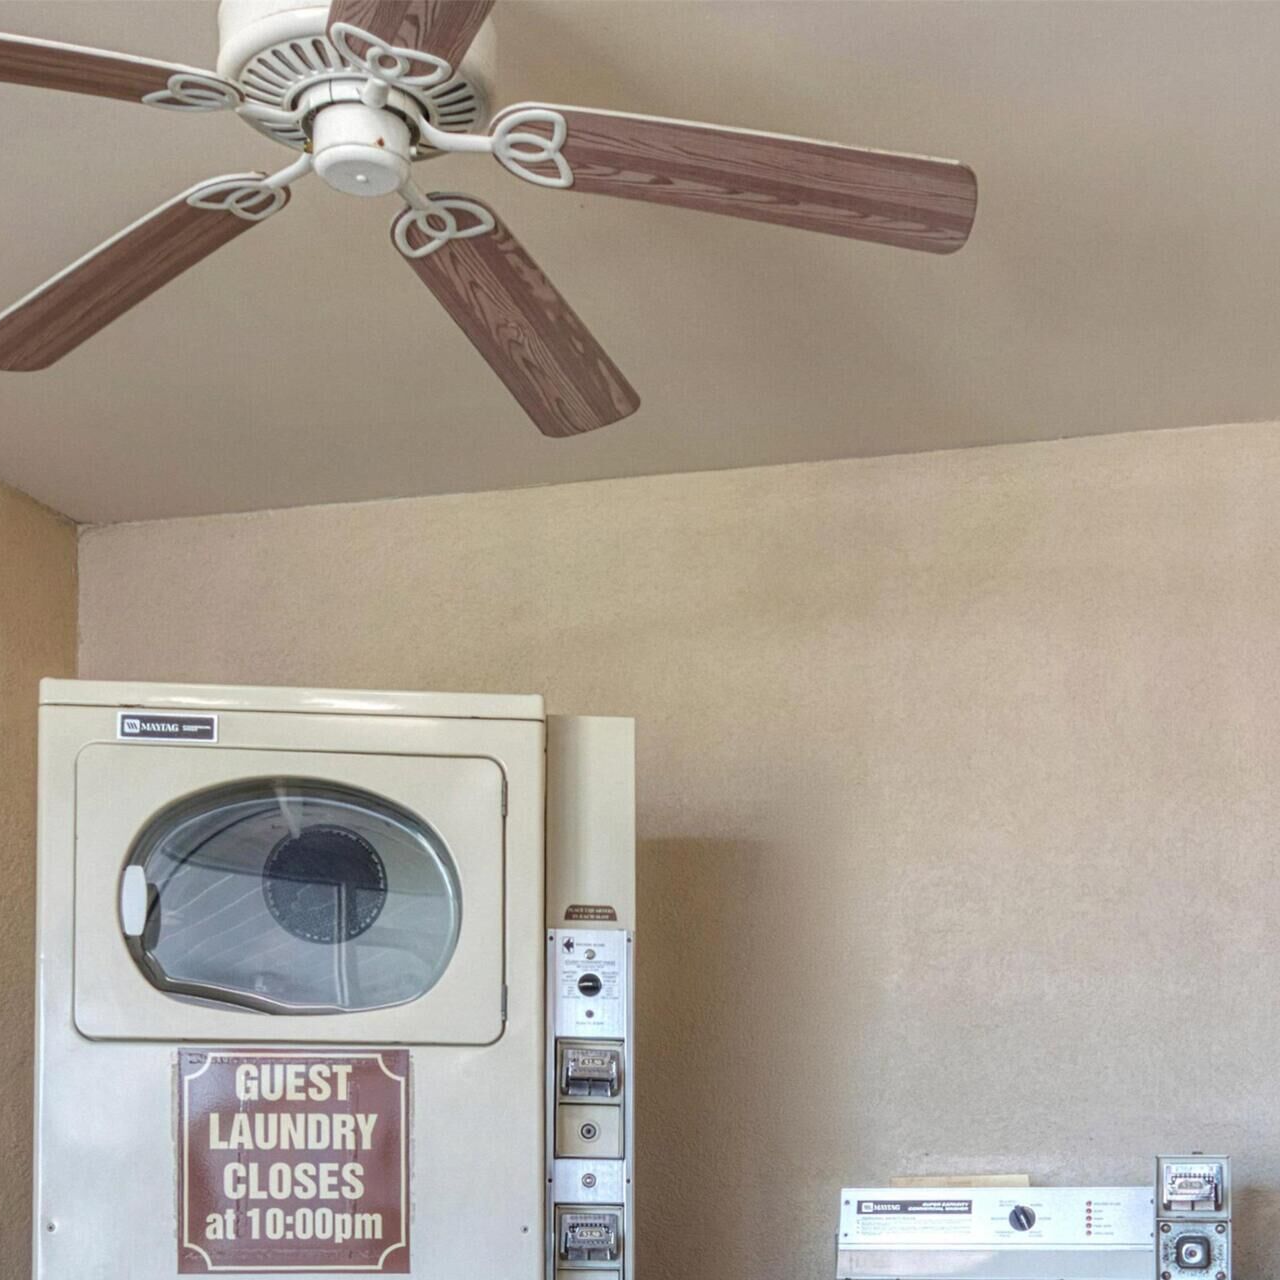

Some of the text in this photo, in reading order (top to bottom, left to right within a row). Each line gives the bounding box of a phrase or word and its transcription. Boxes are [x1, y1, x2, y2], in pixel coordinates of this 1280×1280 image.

[140, 722, 179, 732] MAYTAG
[235, 1063, 352, 1101] GUEST
[209, 1112, 378, 1150] LAUNDRY
[223, 1162, 365, 1200] CLOSES
[205, 1207, 383, 1244] at 10:00pm
